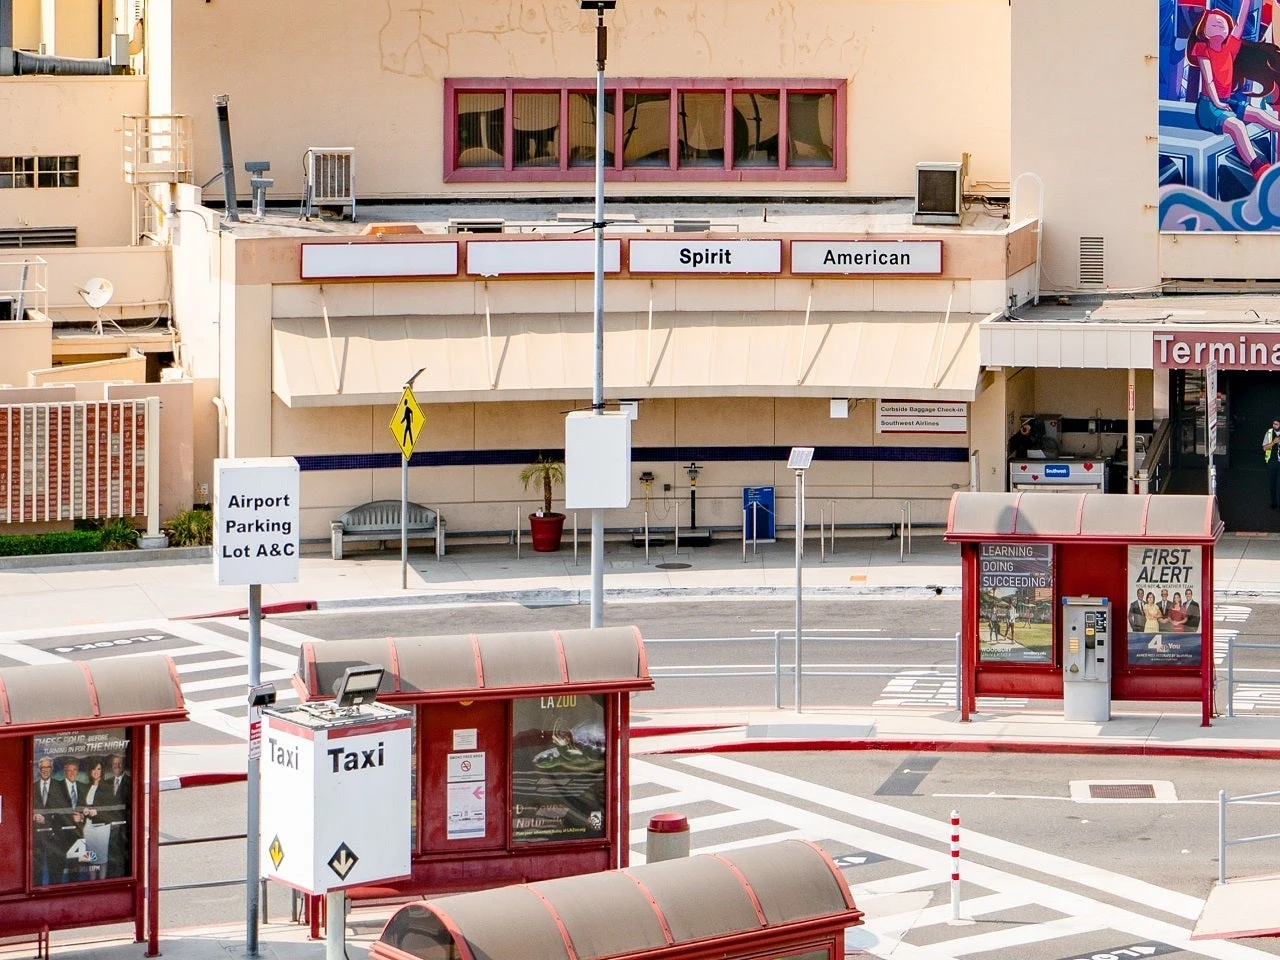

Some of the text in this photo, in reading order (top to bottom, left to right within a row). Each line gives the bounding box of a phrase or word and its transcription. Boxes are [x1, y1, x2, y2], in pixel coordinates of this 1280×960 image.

[679, 246, 732, 268] Spirit
[823, 249, 911, 266] American
[228, 494, 290, 511] Airport
[226, 519, 292, 535] Parking
[222, 543, 295, 558] Lot A&C
[982, 546, 1033, 557] LEARNING
[1141, 547, 1192, 565] FIRST
[982, 561, 1014, 572] DOING
[1135, 566, 1193, 583] ALERT
[982, 576, 1046, 587] SUCCEEDING
[1168, 642, 1181, 650] You
[540, 694, 577, 709] LA ZOO
[85, 743, 104, 752] THE
[103, 739, 131, 750] NIGHT
[268, 737, 300, 771] Taxi
[327, 741, 385, 773] Taxi
[66, 838, 87, 863] 4
